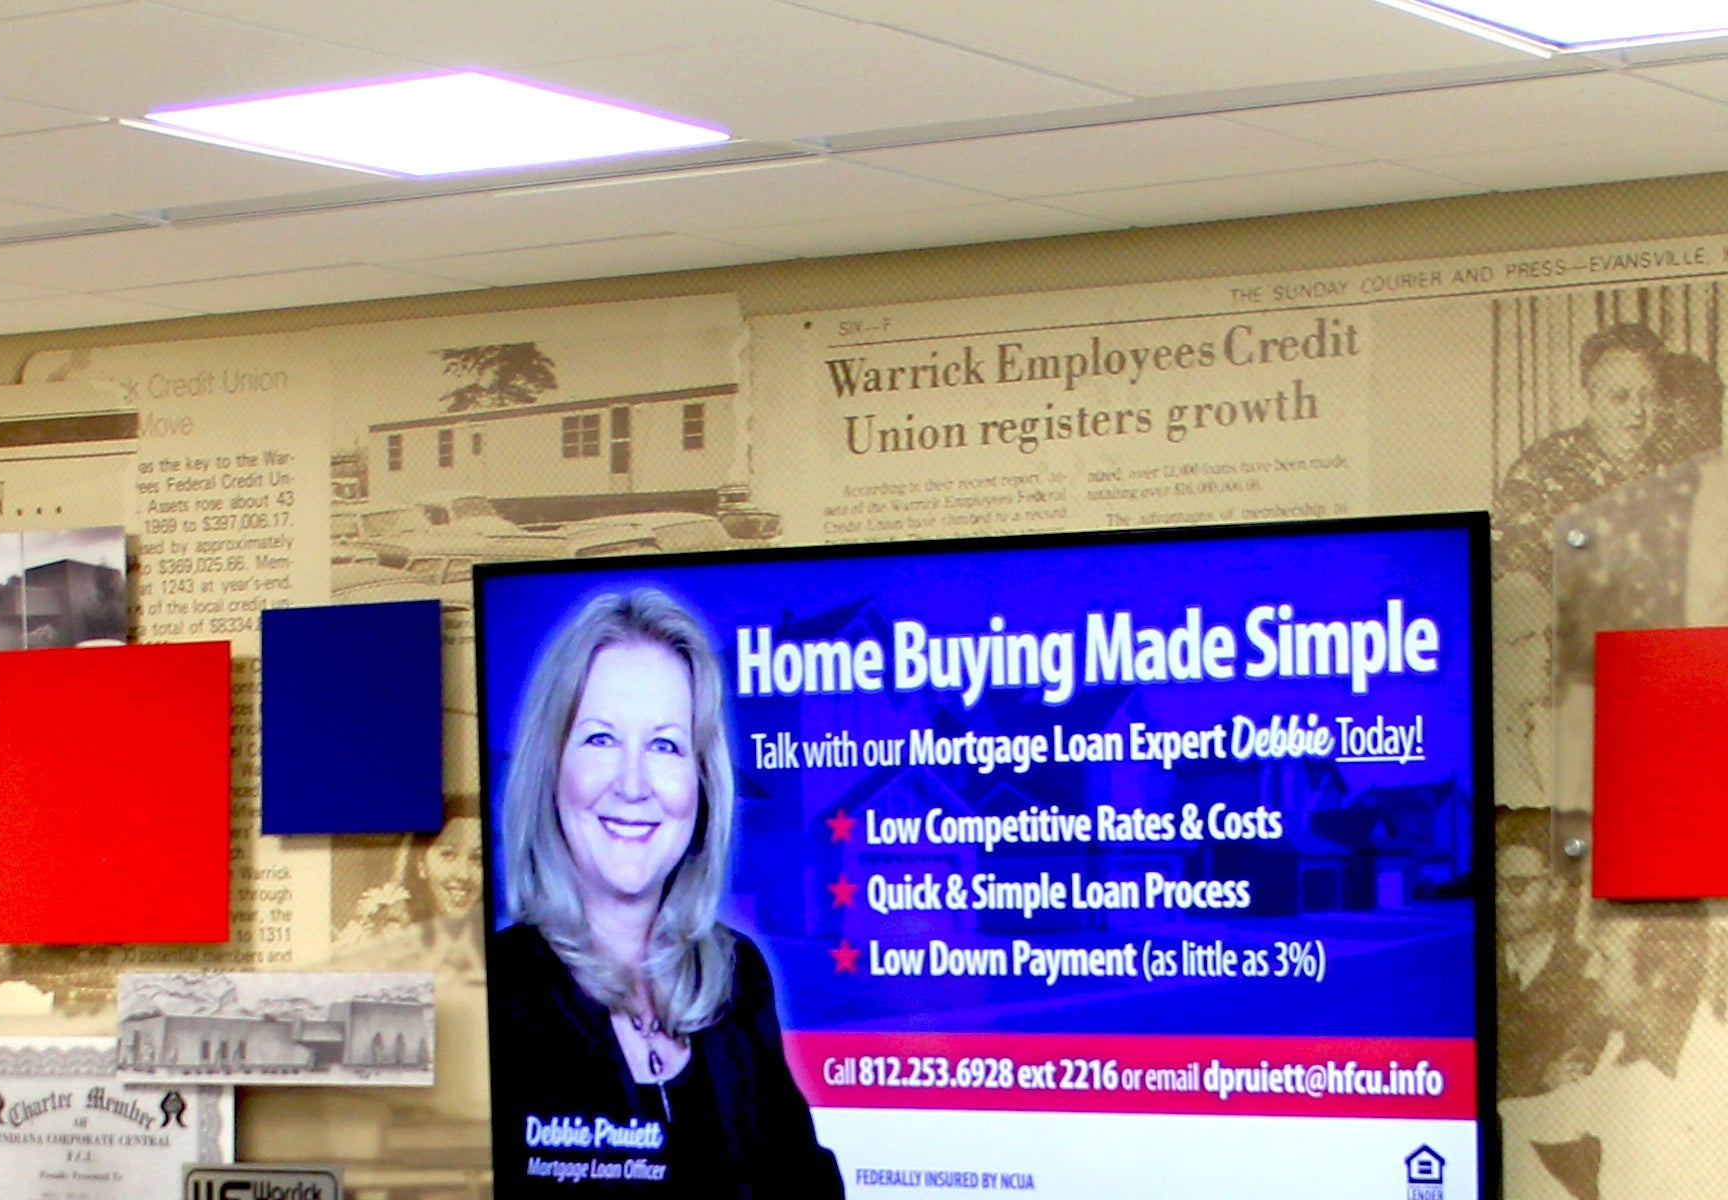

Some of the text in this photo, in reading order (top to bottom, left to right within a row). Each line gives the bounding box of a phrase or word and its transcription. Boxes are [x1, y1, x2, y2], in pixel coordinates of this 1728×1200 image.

[1272, 281, 1348, 301] SUNDAY
[1359, 271, 1442, 294] COURIER
[825, 318, 1360, 399] Warrick Employees Credit
[844, 379, 1320, 456] Union registers growth
[166, 475, 216, 493] Federal
[736, 598, 1440, 709] Home Buying Made Simple
[750, 712, 1426, 775] Talk with our Mortgage Loan Expert Debbie Today!
[865, 803, 1283, 852] Low Competitive Rates & Costs
[866, 871, 1252, 918] Quick & Simple Loan Process
[869, 939, 1327, 985] Low Down Payment (as little as 3%)
[823, 1056, 1445, 1100] Call 812.253.6928 ext 2216 or email dpruiett@hfcu.info
[8, 1085, 158, 1130] Charter Member
[47, 1132, 114, 1146] CORPORATE
[119, 1133, 172, 1147] CENTRAL
[526, 1115, 664, 1150] Debbie Pruiett
[527, 1157, 667, 1183] Mortgage Loan Officer
[855, 1168, 1035, 1190] FEDERALLY INSURED BY NCUA
